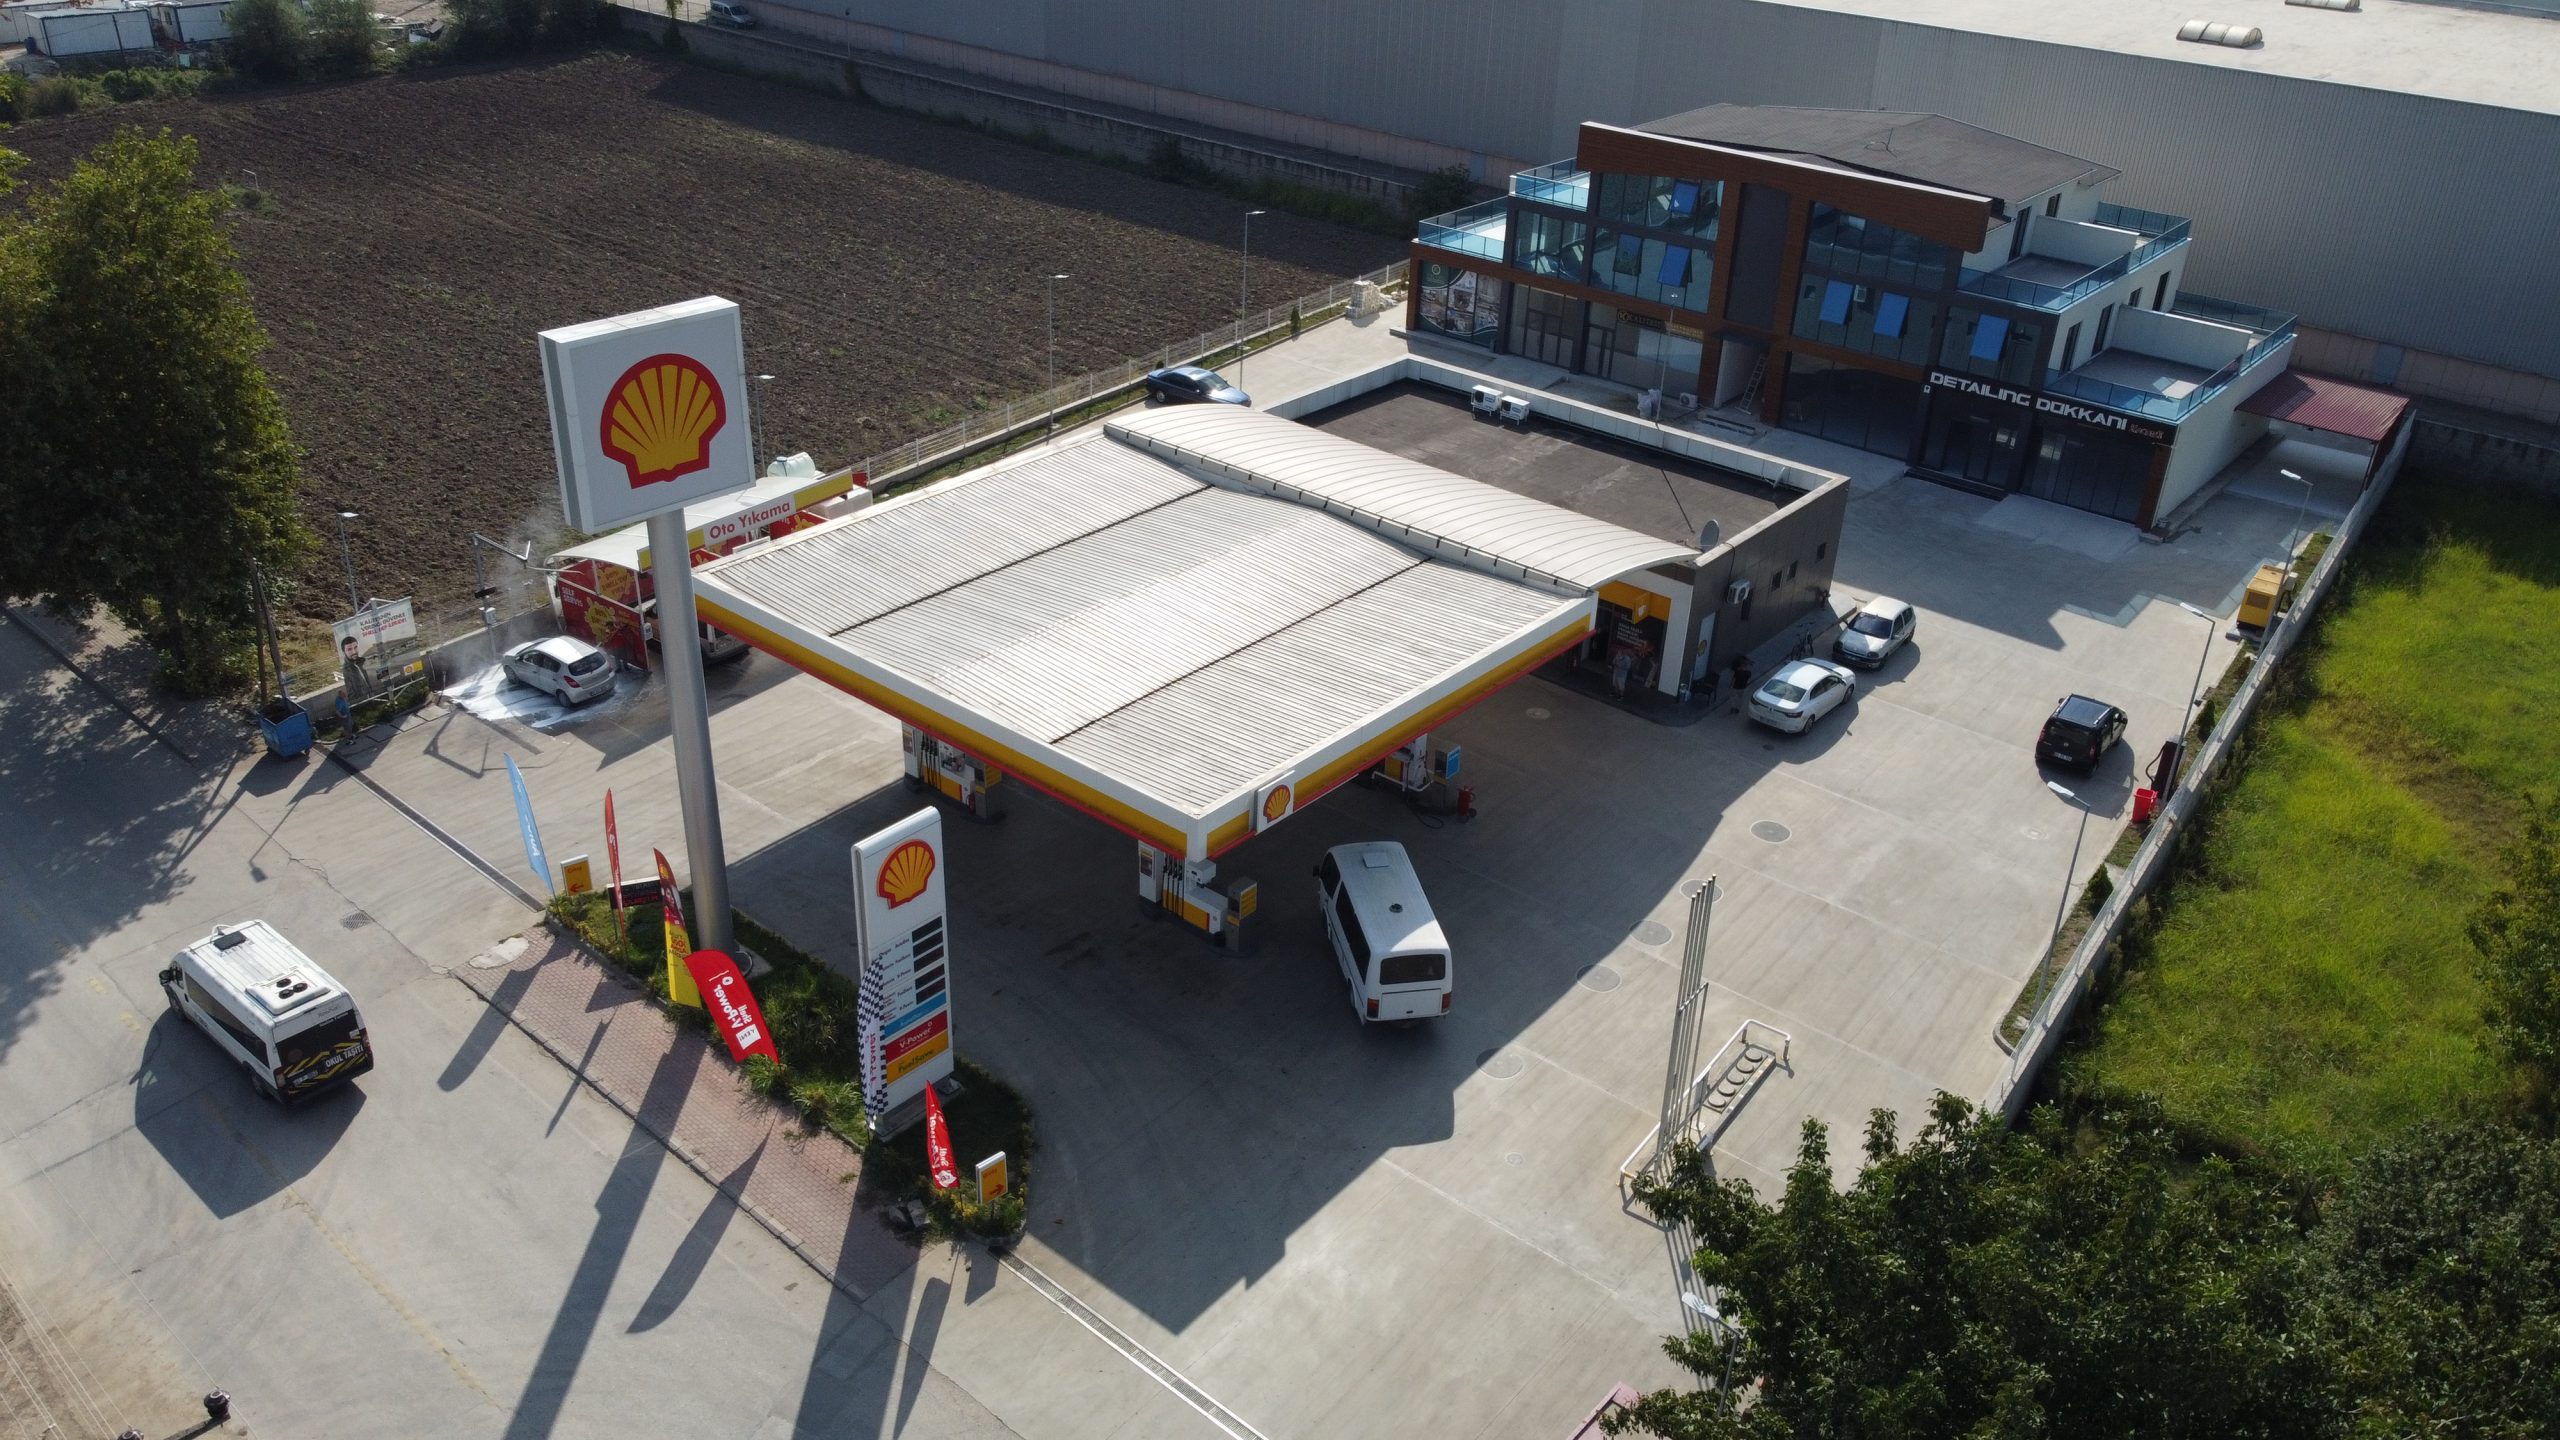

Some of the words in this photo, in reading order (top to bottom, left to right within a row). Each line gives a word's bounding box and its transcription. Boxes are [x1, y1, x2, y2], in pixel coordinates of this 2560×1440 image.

[1929, 371, 2031, 407] DETAILING
[709, 523, 736, 539] Oto
[738, 502, 790, 528] Yıkama
[900, 1026, 933, 1049] V-Power
[325, 1054, 344, 1068] OKUL
[897, 1049, 935, 1072] FuelSave
